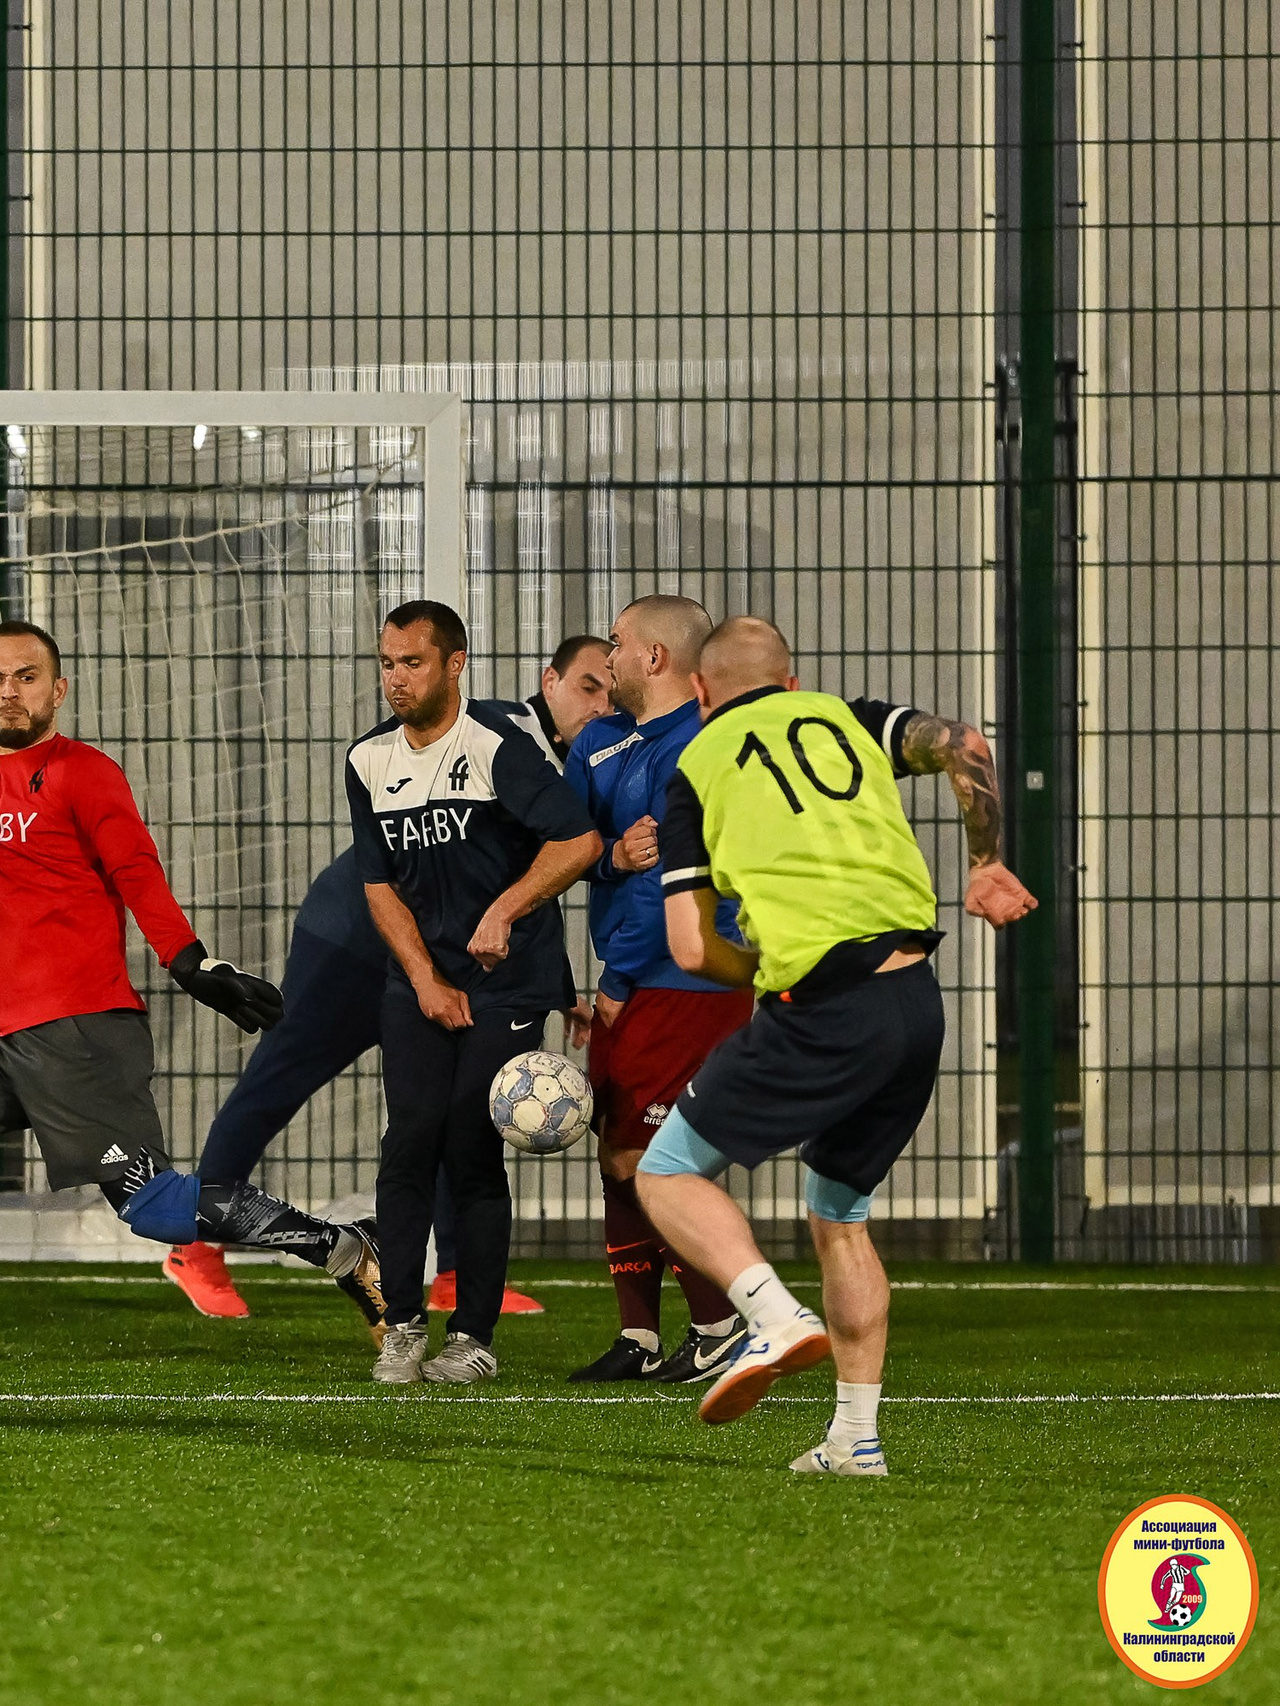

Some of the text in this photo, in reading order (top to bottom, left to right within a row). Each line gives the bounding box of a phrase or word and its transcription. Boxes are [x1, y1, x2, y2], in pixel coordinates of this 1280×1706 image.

[735, 716, 863, 815] 10
[380, 807, 473, 851] FARBY
[100, 1154, 129, 1165] adidas
